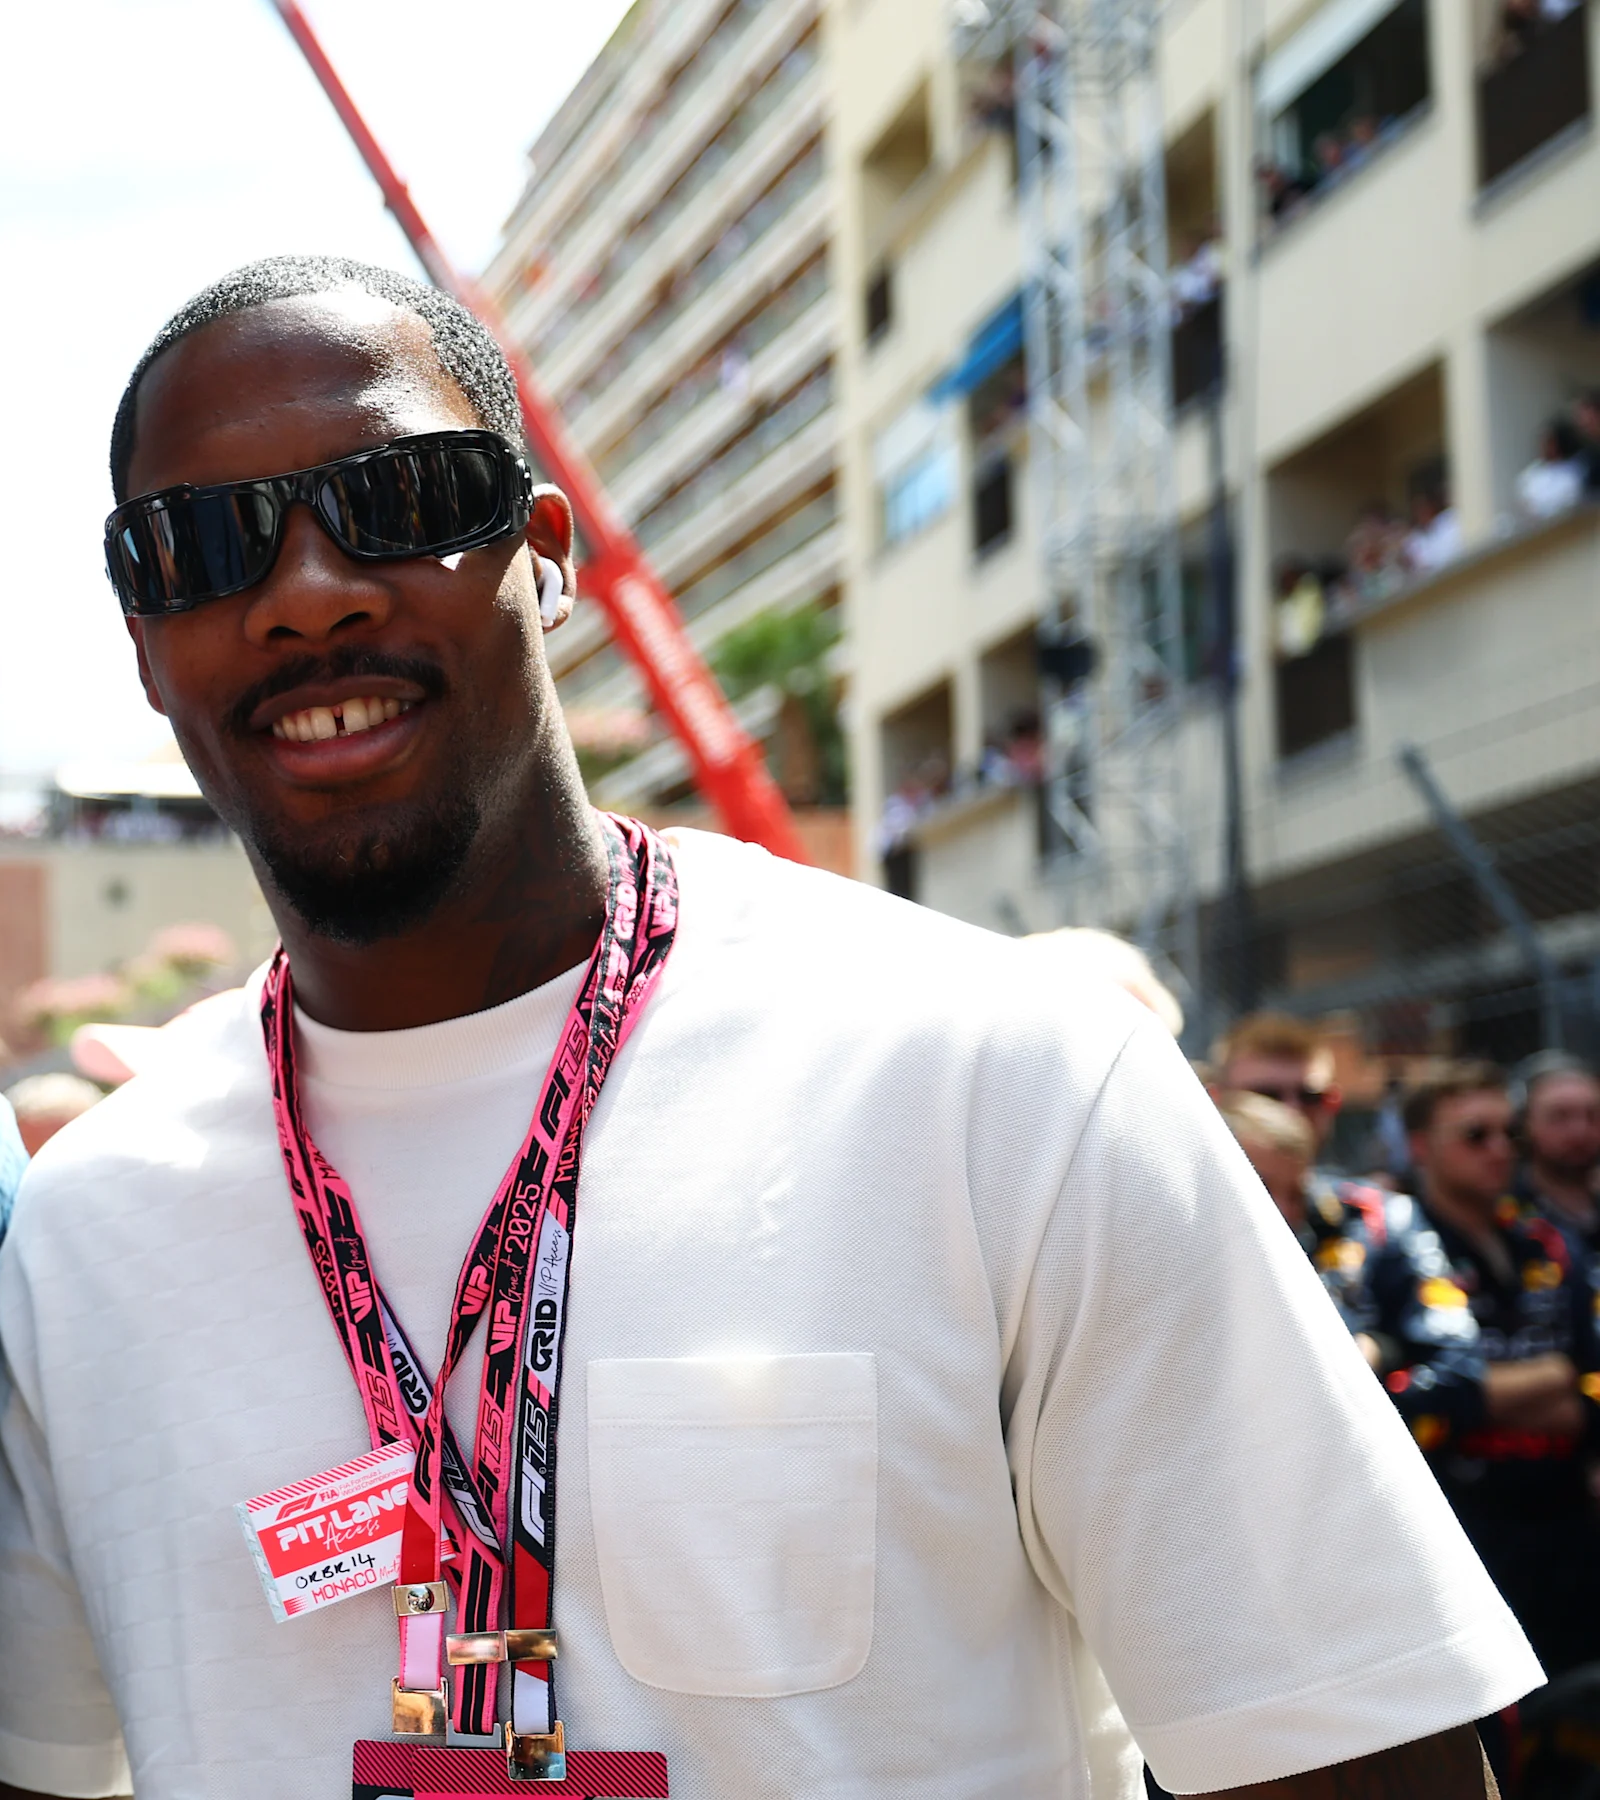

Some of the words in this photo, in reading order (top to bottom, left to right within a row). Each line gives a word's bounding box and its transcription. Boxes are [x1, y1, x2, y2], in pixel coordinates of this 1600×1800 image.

[613, 881, 638, 940] GRID
[558, 1020, 589, 1075] 75
[505, 1180, 541, 1254] 2025
[334, 1233, 367, 1270] Guest
[543, 1229, 563, 1267] Access
[345, 1271, 373, 1324] VIP
[460, 1265, 491, 1316] VIP
[500, 1254, 525, 1302] Guest
[538, 1266, 559, 1296] VIP
[490, 1300, 517, 1355] VIP
[530, 1298, 557, 1372] GRID
[366, 1371, 399, 1428] 75
[479, 1400, 504, 1463] 75
[522, 1398, 548, 1465] 75
[521, 1457, 546, 1548] F1
[276, 1515, 327, 1552] PIT
[323, 1519, 380, 1552] Access
[295, 1561, 351, 1589] ORBR
[351, 1553, 376, 1569] 14
[312, 1568, 377, 1604] MONACO
